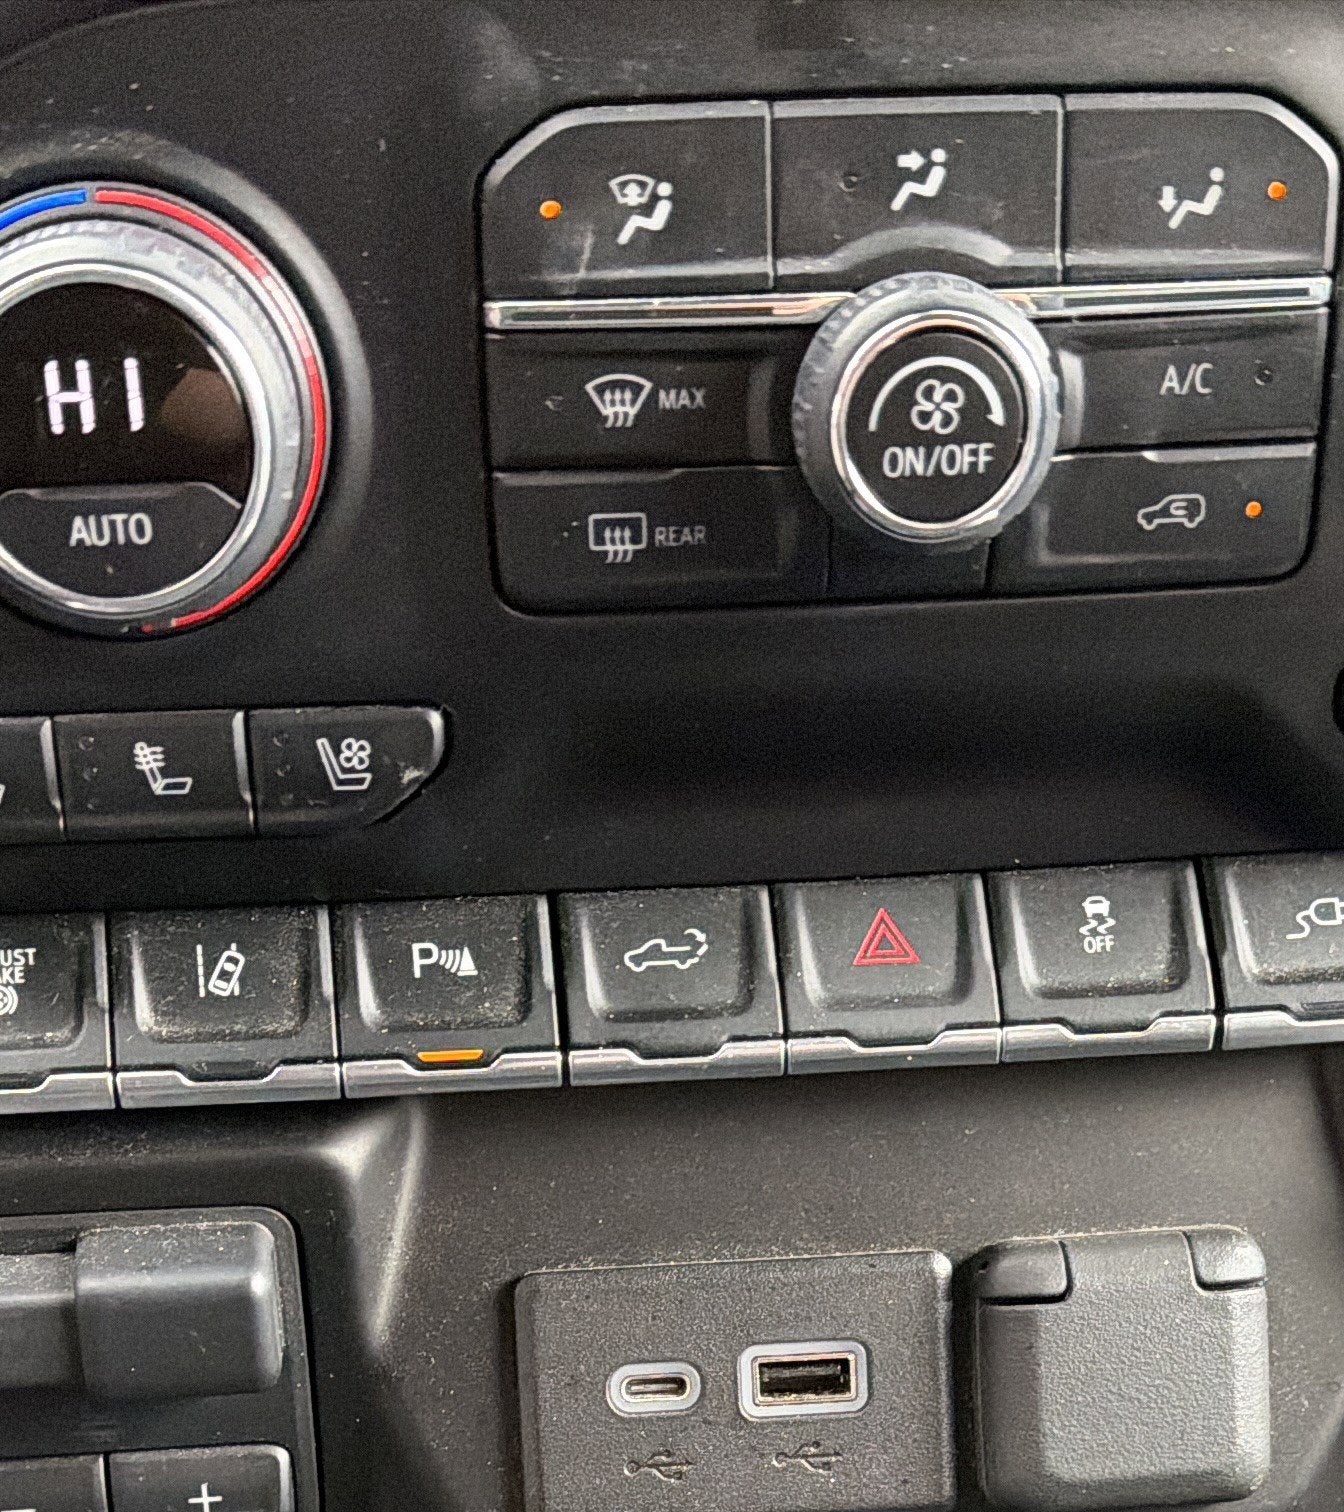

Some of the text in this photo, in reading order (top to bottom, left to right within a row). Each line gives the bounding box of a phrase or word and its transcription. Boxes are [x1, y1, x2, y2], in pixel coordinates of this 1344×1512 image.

[42, 356, 146, 435] HI
[1159, 363, 1214, 397] A/C
[657, 386, 707, 411] MAX
[881, 442, 995, 480] ON/OFF
[68, 512, 154, 548] AUTO
[655, 523, 708, 547] REAR
[1083, 934, 1115, 955] OFF
